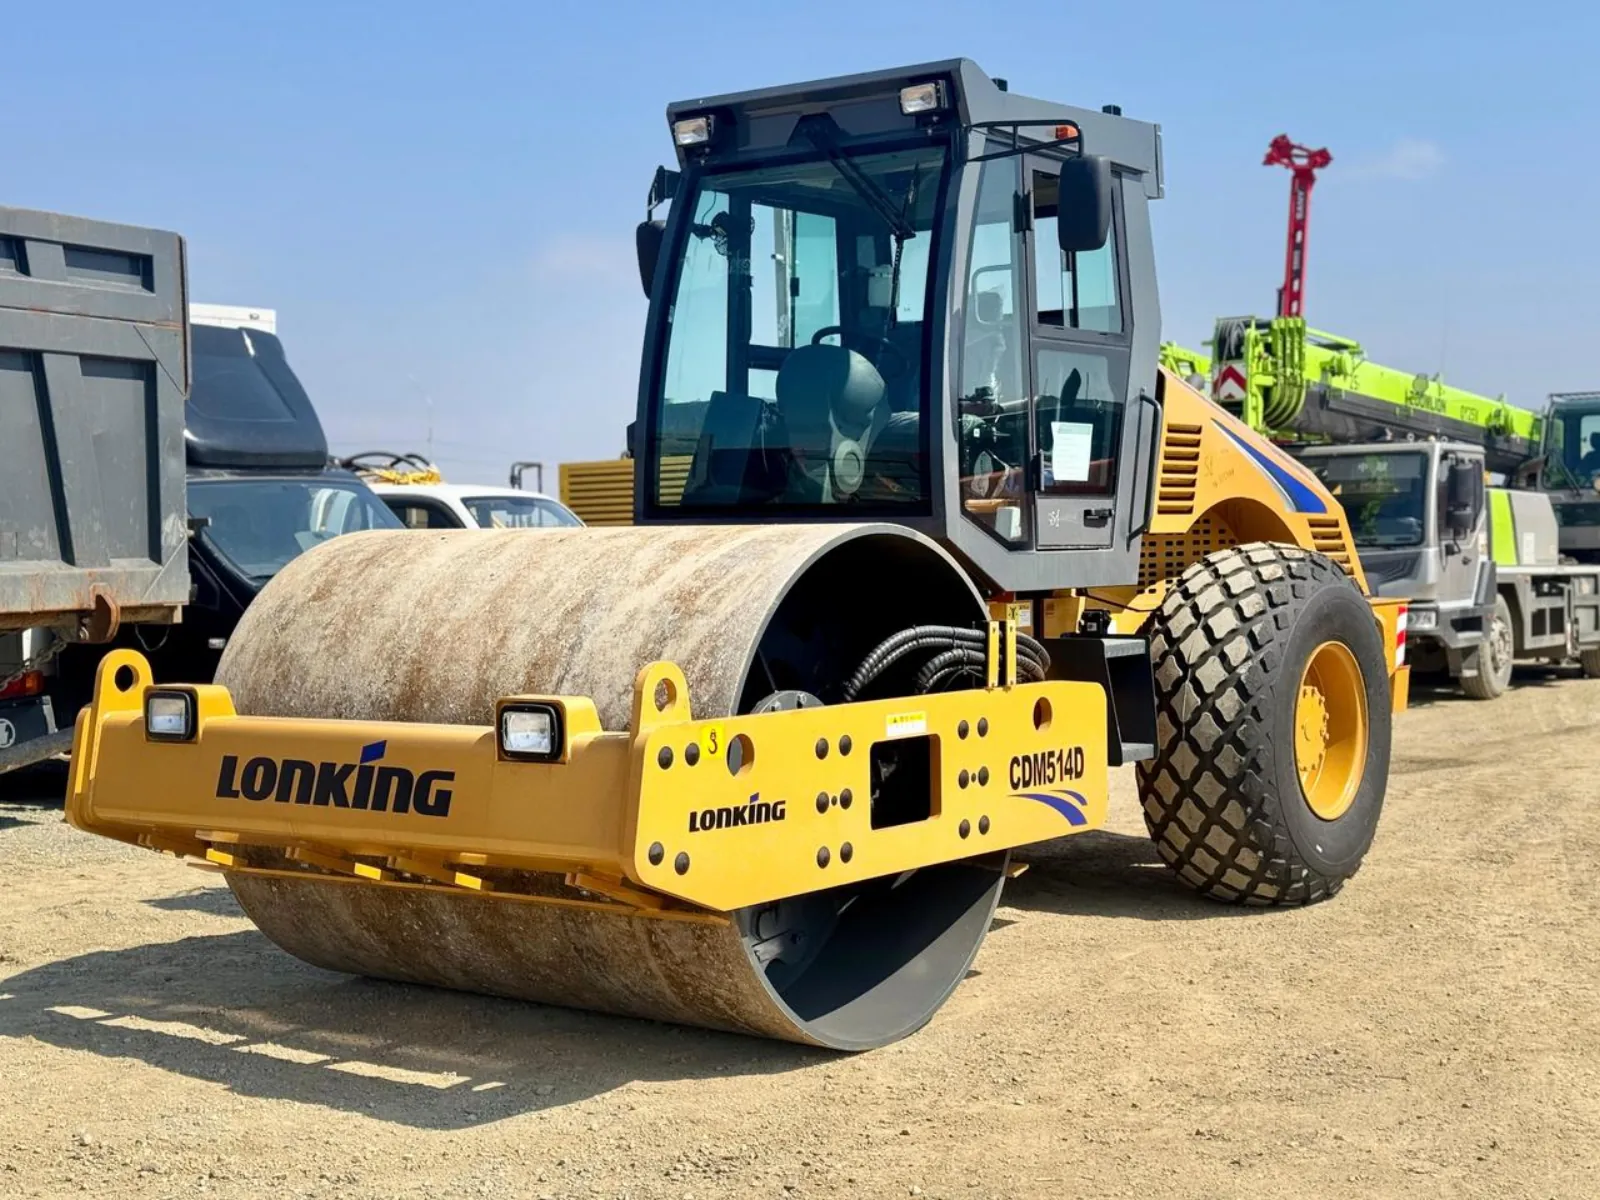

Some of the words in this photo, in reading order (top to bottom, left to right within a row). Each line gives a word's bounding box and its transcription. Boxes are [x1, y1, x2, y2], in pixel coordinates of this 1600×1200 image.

[216, 740, 456, 817] LONKING
[1009, 746, 1085, 790] CDM514D
[689, 792, 786, 833] LONKING
